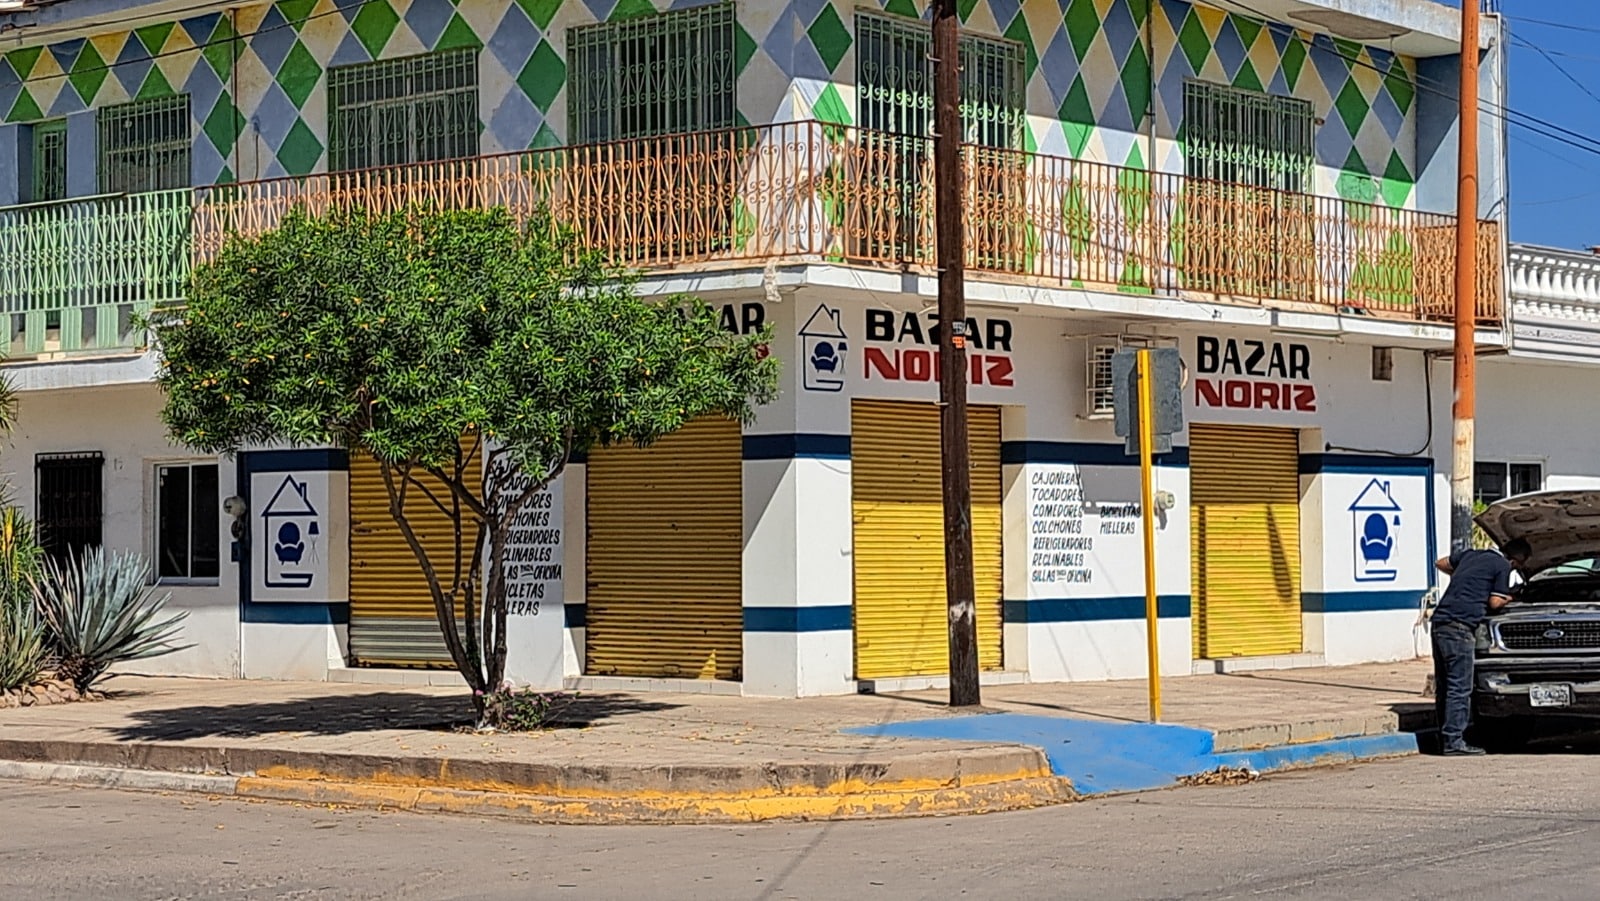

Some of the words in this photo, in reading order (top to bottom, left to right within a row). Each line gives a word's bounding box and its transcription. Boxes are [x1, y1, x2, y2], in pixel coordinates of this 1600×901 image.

[1197, 335, 1310, 380] BAZAR
[864, 347, 1014, 387] NOIZ
[1195, 378, 1316, 412] NORIZ
[1032, 470, 1081, 486] CAJONERAS
[1032, 488, 1083, 502] TOCADORES
[1032, 504, 1083, 518] COMEDORES
[1032, 520, 1082, 534] COLCHONES
[1100, 521, 1135, 535] HIELERAS
[1033, 537, 1093, 551] REFRIGERADORES
[489, 547, 552, 562] CLINABLES
[1032, 552, 1084, 566] RECLINABLES
[1032, 570, 1056, 583] SILLAS
[1067, 568, 1092, 583] OFICINA
